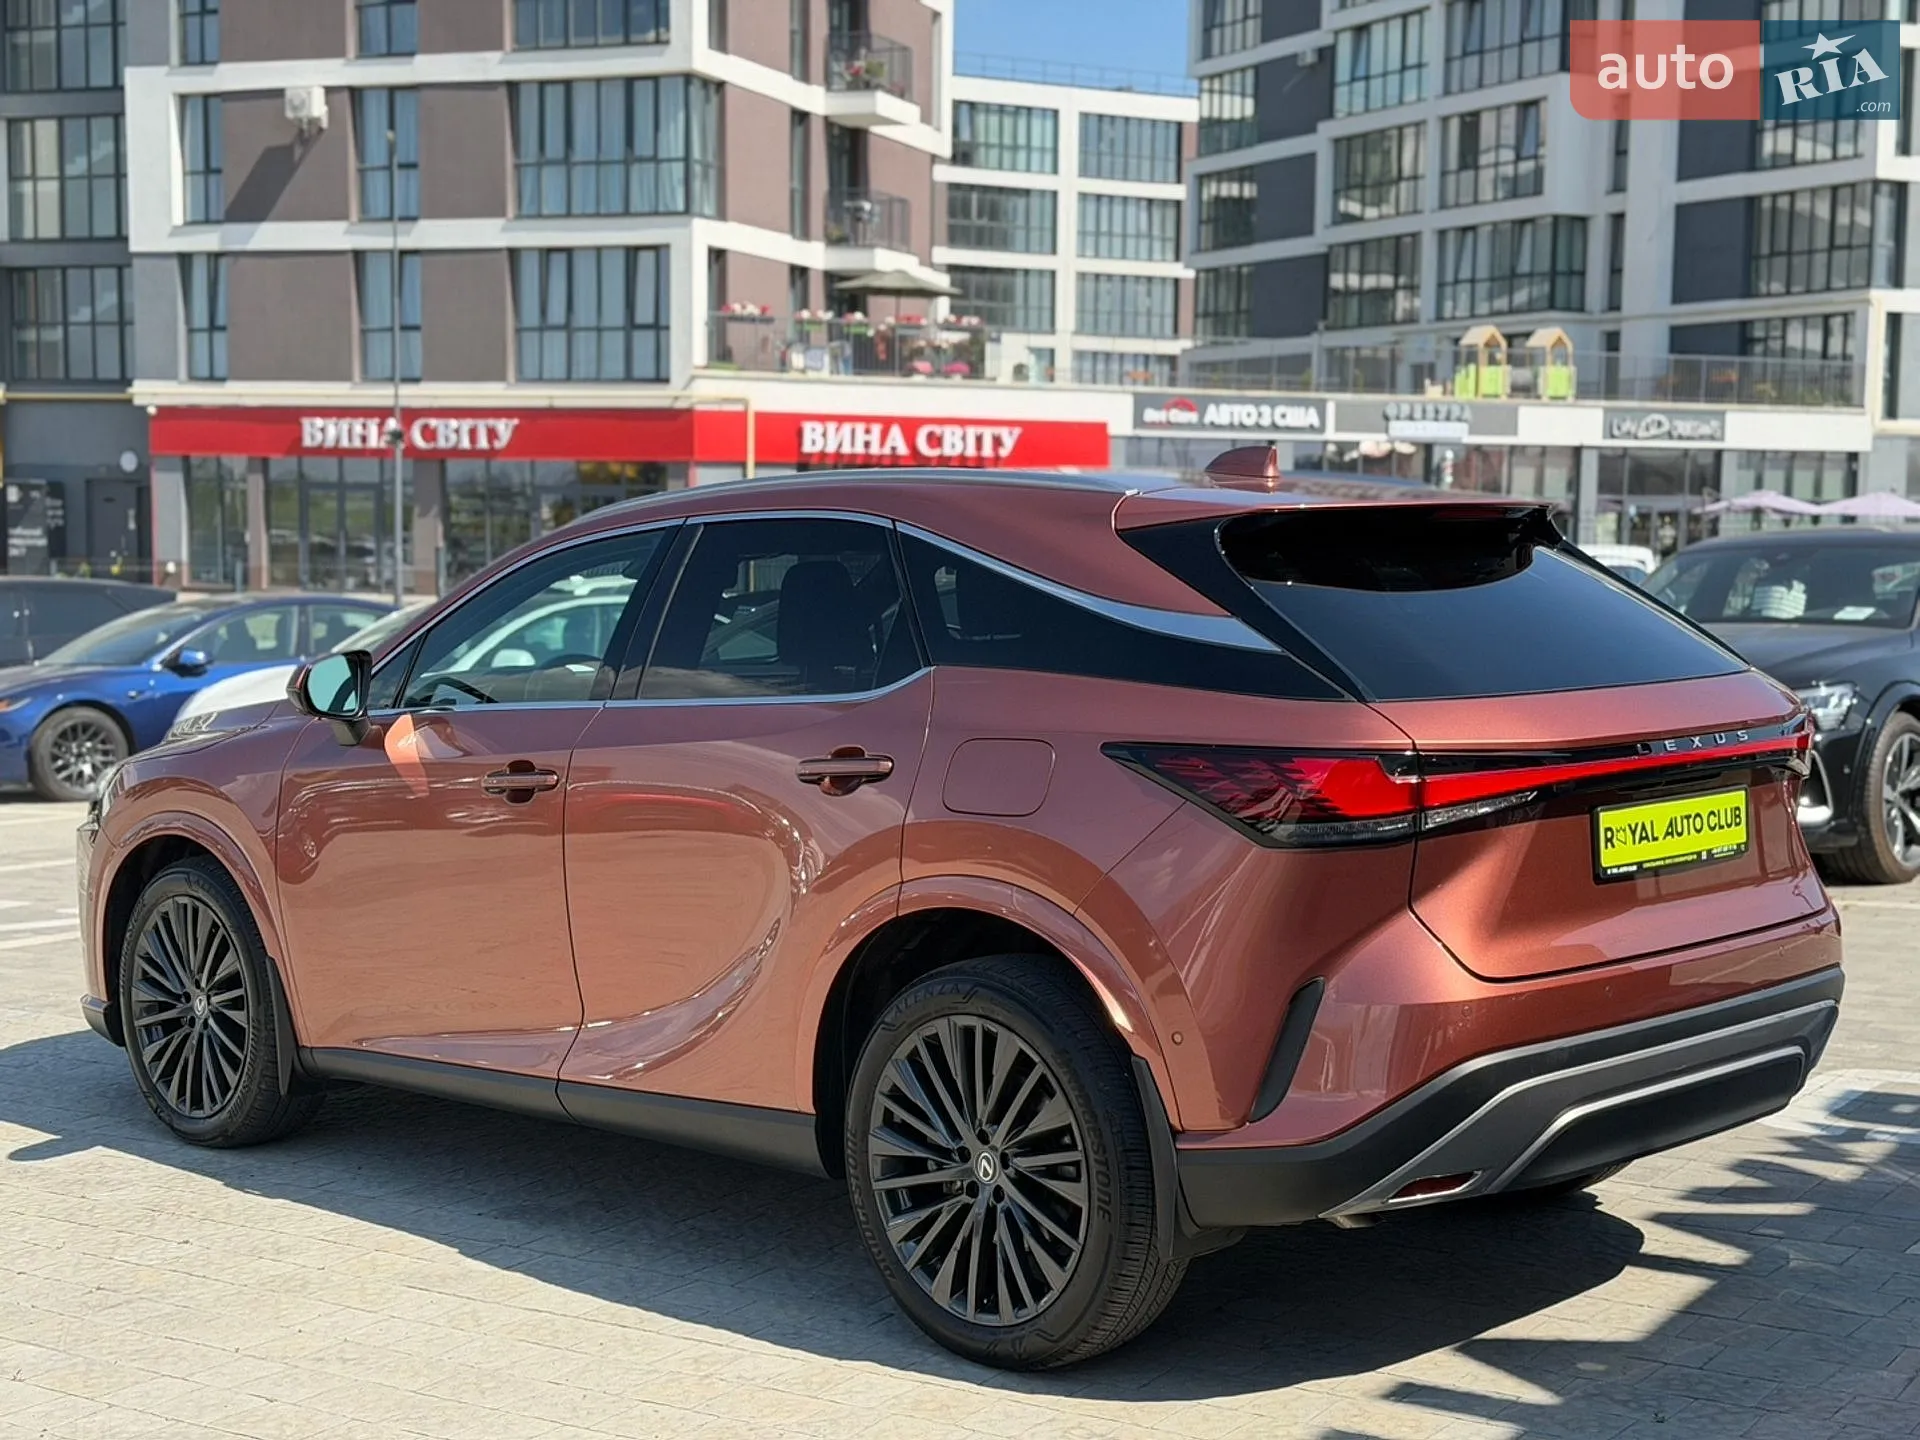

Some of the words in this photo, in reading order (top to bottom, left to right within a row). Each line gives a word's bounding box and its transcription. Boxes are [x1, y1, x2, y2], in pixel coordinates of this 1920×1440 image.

[1203, 403, 1257, 426] АВТО
[1273, 405, 1321, 429] США
[299, 416, 404, 449] ВИНА
[410, 417, 519, 451] СВІТУ
[800, 419, 911, 456] ВИНА
[914, 424, 1022, 459] СВІТУ
[1637, 730, 1749, 754] LEXUS
[1662, 811, 1704, 841] AUTO
[1706, 805, 1742, 833] CLUB
[893, 983, 960, 1016] ALENZA
